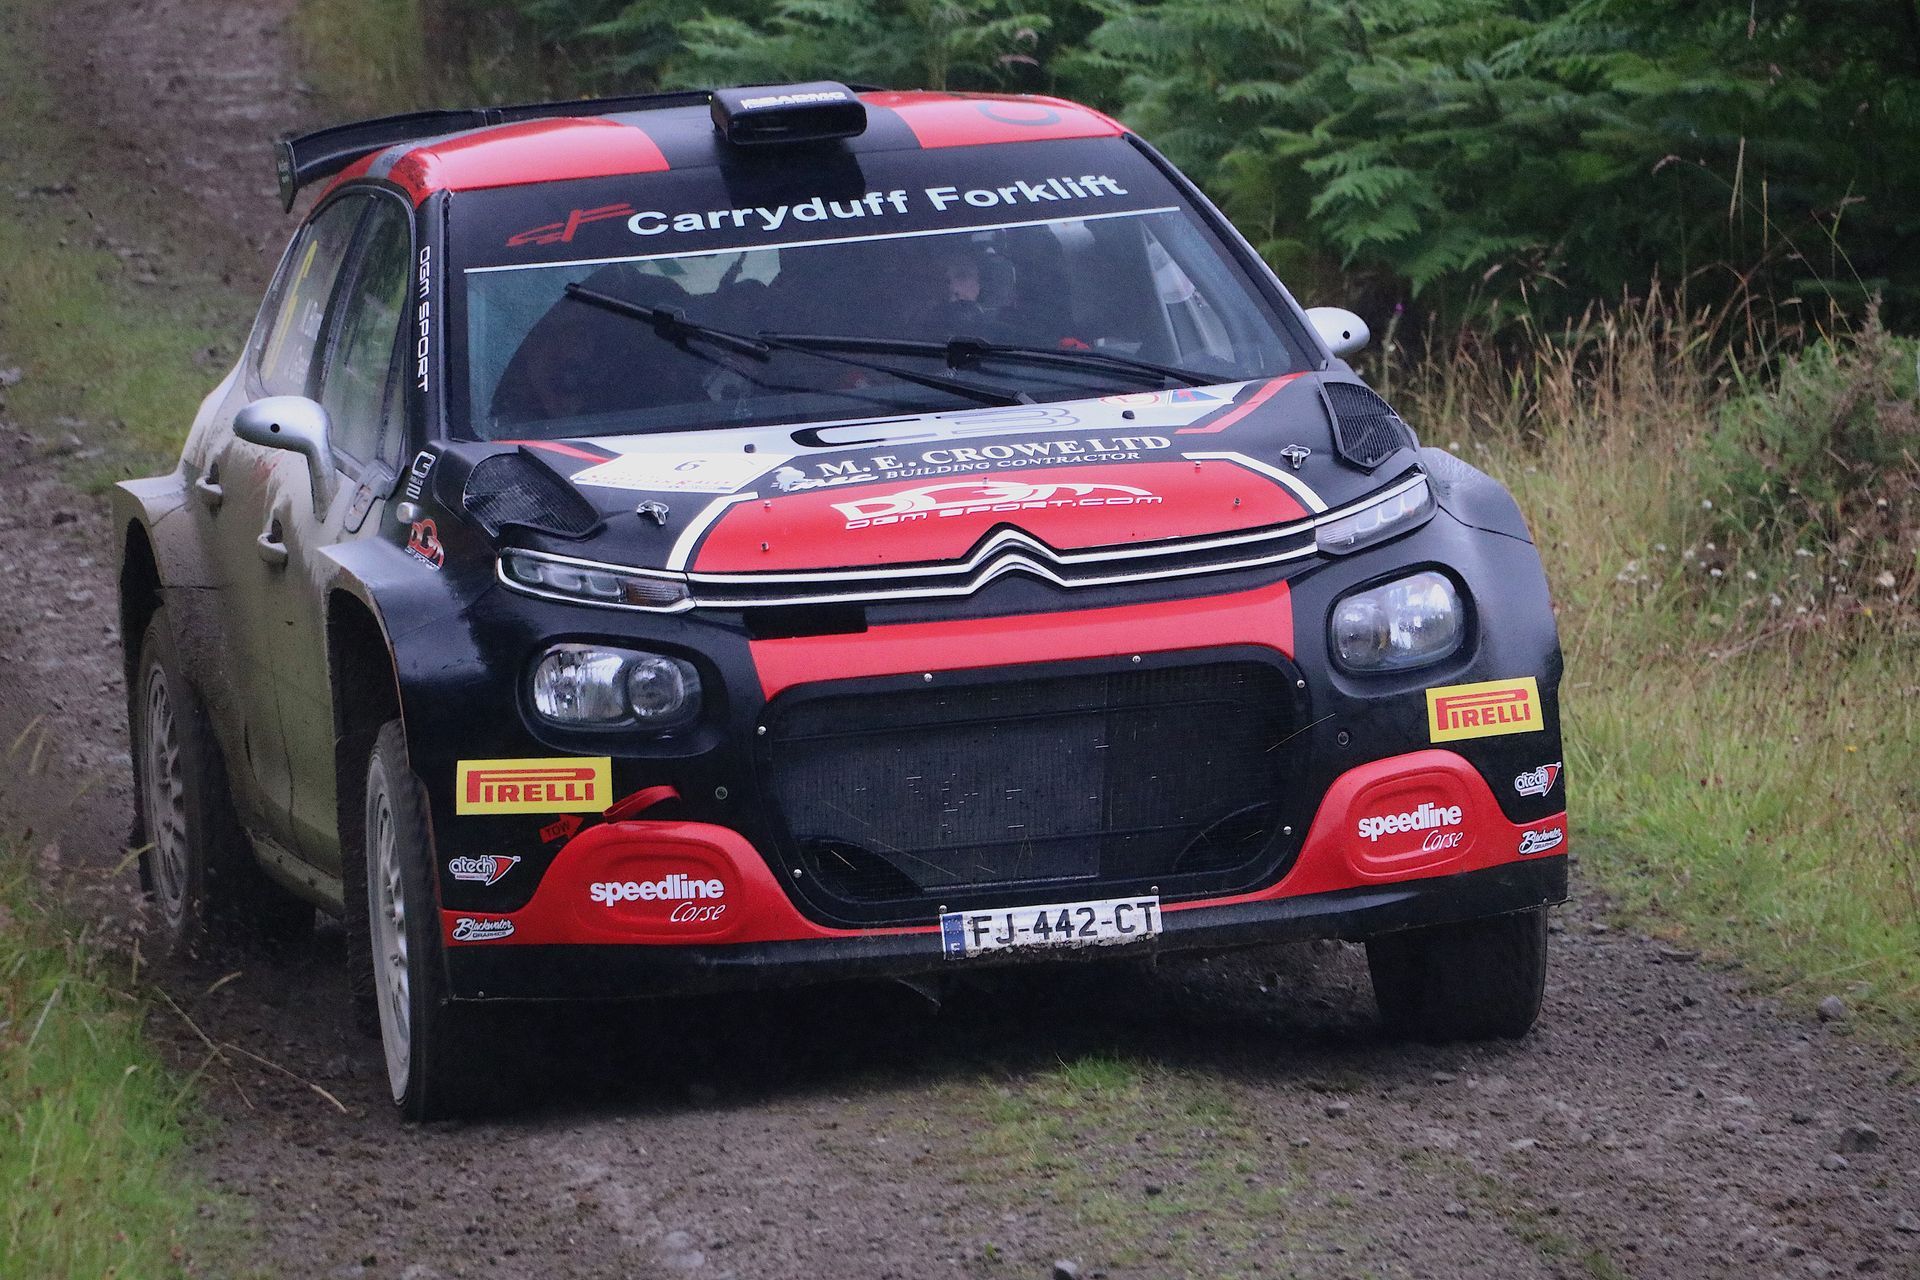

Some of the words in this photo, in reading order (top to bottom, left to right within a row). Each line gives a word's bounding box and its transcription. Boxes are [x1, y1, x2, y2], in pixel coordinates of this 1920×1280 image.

[627, 189, 909, 237] Carryduff
[924, 174, 1129, 212] Forklift
[417, 301, 431, 393] SPORT
[885, 461, 991, 480] BUILDING
[996, 450, 1141, 468] CONTRACTOR
[921, 440, 1086, 466] CROWE
[1085, 435, 1173, 453] LTD
[1434, 688, 1532, 731] PIRELLI
[466, 767, 596, 804] PIRELLI
[1514, 765, 1550, 792] atech
[544, 821, 572, 837] TOW
[1358, 802, 1463, 842] speedline
[1422, 829, 1464, 852] Corse
[449, 855, 498, 877] atech
[589, 873, 725, 907] speedline
[669, 901, 726, 923] Corse
[971, 901, 1157, 947] FJ-442-CT
[453, 917, 513, 939] Blackwater
